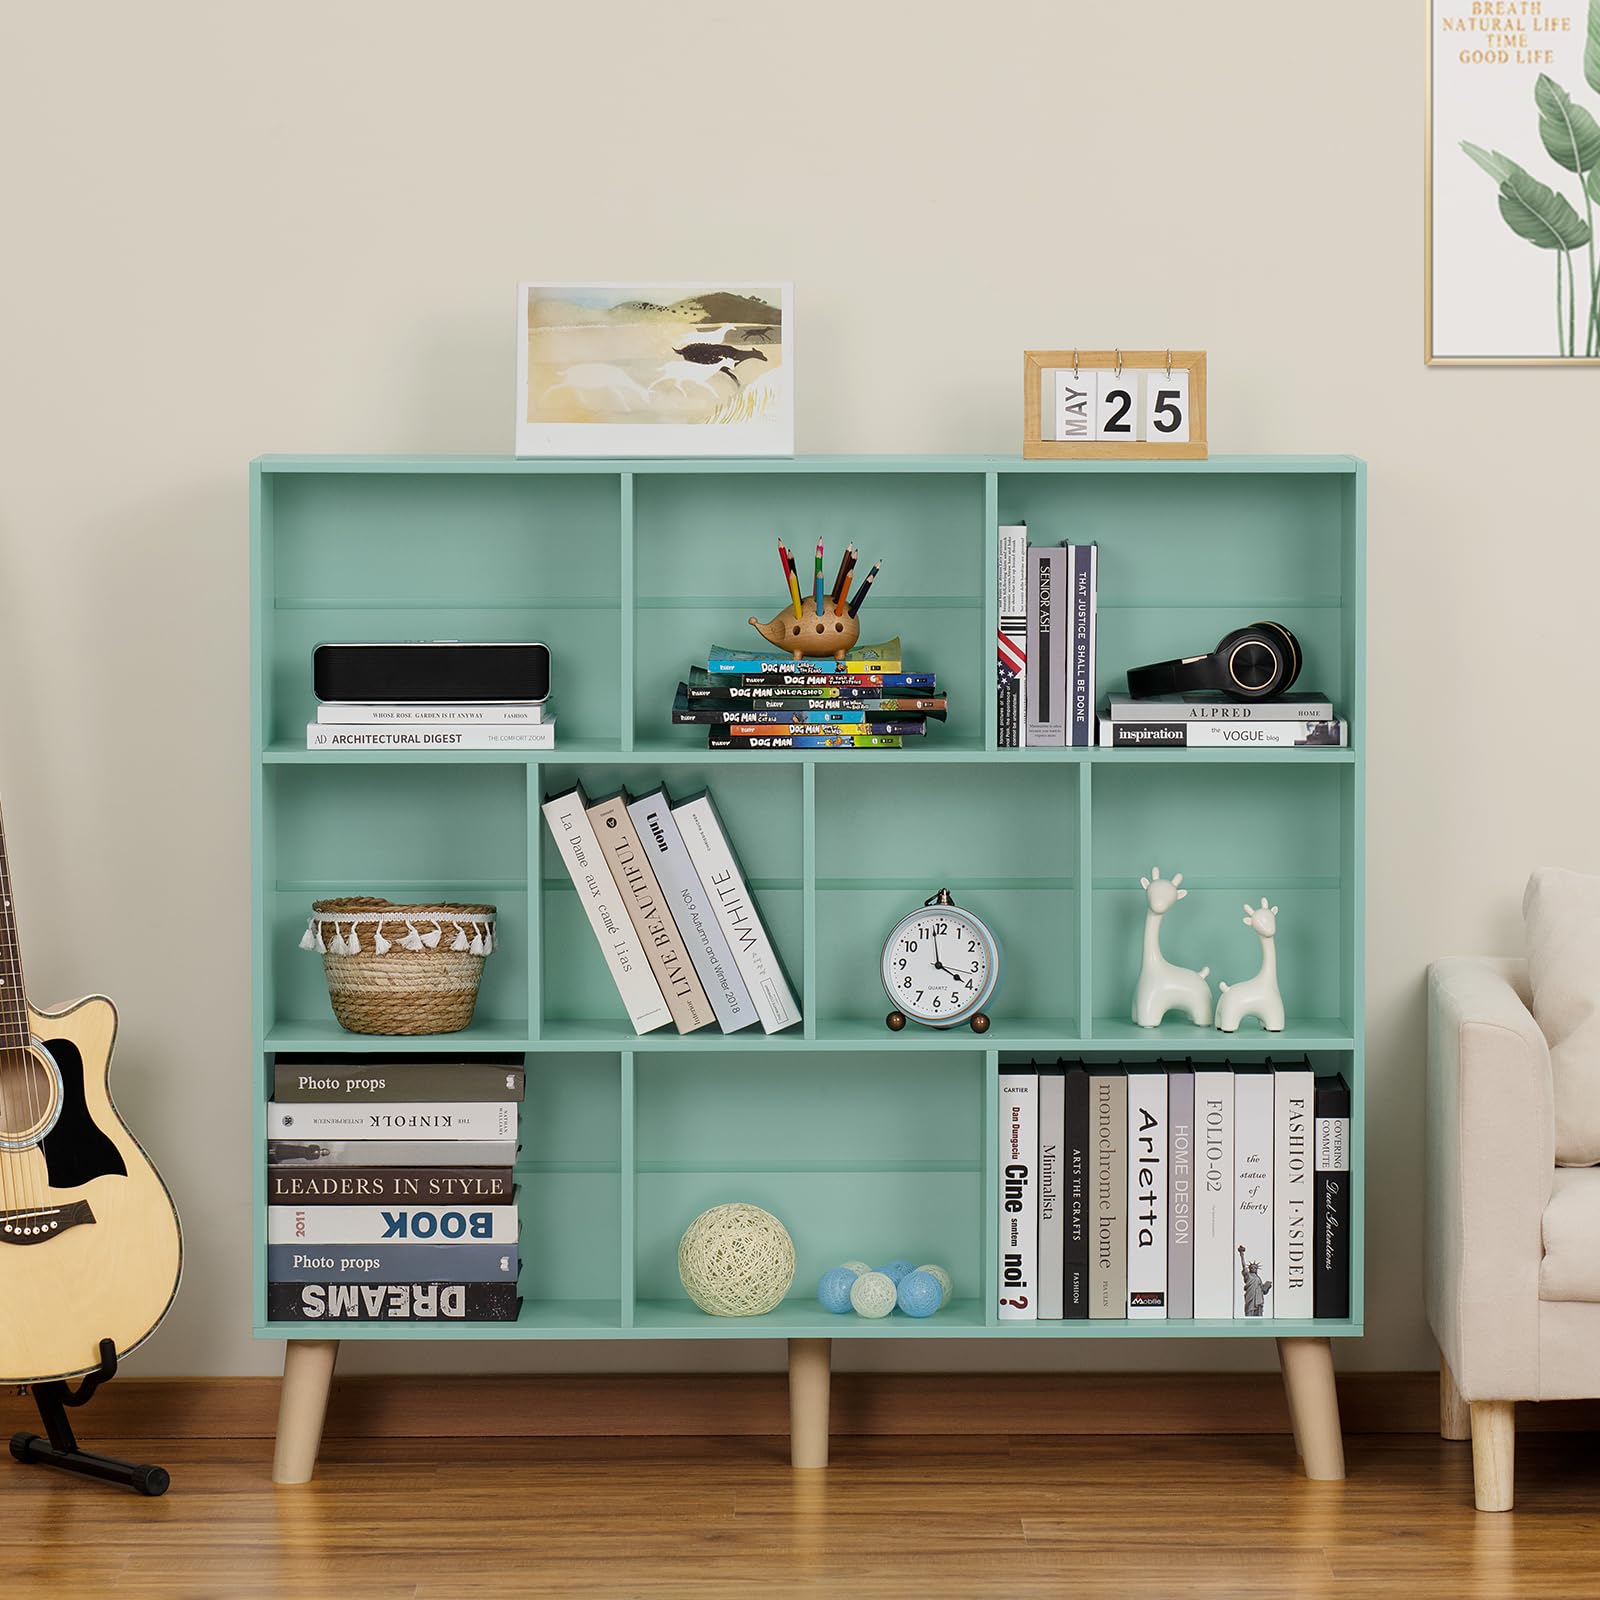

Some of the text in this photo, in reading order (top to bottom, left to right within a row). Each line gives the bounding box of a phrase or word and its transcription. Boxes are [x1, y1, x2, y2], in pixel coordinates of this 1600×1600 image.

[1472, 1, 1542, 16] BREATH
[1443, 17, 1571, 31] NATURAL LIFE
[1486, 34, 1528, 48] TIME
[1459, 50, 1554, 64] GOOD LIFE
[1065, 386, 1182, 436] MAY 2 5
[1040, 566, 1051, 633] SENIOR ASH
[1076, 572, 1087, 722] THAT JUSTICE SHALL BE DONE
[761, 663, 778, 673] DOG
[779, 663, 795, 672] MAN
[784, 676, 805, 685] DOG
[806, 676, 827, 685] MAN
[730, 688, 751, 697] DOG
[752, 688, 772, 697] MAN
[808, 699, 824, 709] DOG
[825, 700, 840, 709] MAN
[723, 712, 757, 722] DOG MAN
[789, 725, 805, 734] DOG
[805, 725, 820, 734] MAN
[1119, 727, 1184, 743] inspiration
[1223, 731, 1264, 741] VOGUE
[315, 734, 462, 745] AD ARCHITECTURAL DIGEST
[750, 738, 793, 747] DOG MAN
[646, 812, 669, 853] Union
[559, 812, 572, 831] La
[569, 835, 588, 868] Dame
[585, 873, 601, 899] aux
[711, 869, 757, 953] WHITE
[614, 835, 701, 1026] Interior LIVE BEAUTIFUL
[919, 928, 929, 939] 11
[935, 923, 948, 935] 12
[956, 928, 961, 939] 1
[681, 888, 740, 1014] NO.9 Autumn and Winter 2018
[905, 941, 918, 952] 10
[967, 940, 975, 952] 2
[898, 958, 907, 970] 9
[970, 961, 979, 973] 3
[903, 976, 912, 988] 8
[965, 979, 974, 990] 4
[915, 991, 924, 1002] 7
[932, 996, 941, 1008] 6
[950, 992, 959, 1004] 5
[298, 1076, 386, 1092] Photo props
[369, 1115, 452, 1127] KINFOLK
[1011, 1107, 1020, 1160] Dan Dungaciu
[1206, 1100, 1223, 1192] FOLIO-02
[1289, 1099, 1304, 1185] FASHION
[1322, 1119, 1331, 1169] COMMUTE
[1334, 1119, 1343, 1169] COVERING
[1175, 1125, 1188, 1175] HOME
[1247, 1154, 1260, 1163] the
[1043, 1145, 1056, 1220] Minimalista
[1099, 1084, 1117, 1269] monochrome home
[1138, 1107, 1160, 1248] Arletta
[275, 1178, 504, 1195] LEADERS IN STYLE
[1004, 1165, 1028, 1213] Cine
[1249, 1186, 1260, 1198] of
[1073, 1149, 1081, 1241] ARTS THE CRAFTS
[1240, 1201, 1268, 1214] liberty
[295, 1211, 305, 1238] 2011
[380, 1211, 493, 1239] BOOK
[292, 1255, 380, 1271] Photo props
[1004, 1254, 1027, 1288] noi
[301, 1284, 466, 1318] DREAMS
[999, 1296, 1029, 1310] ?
